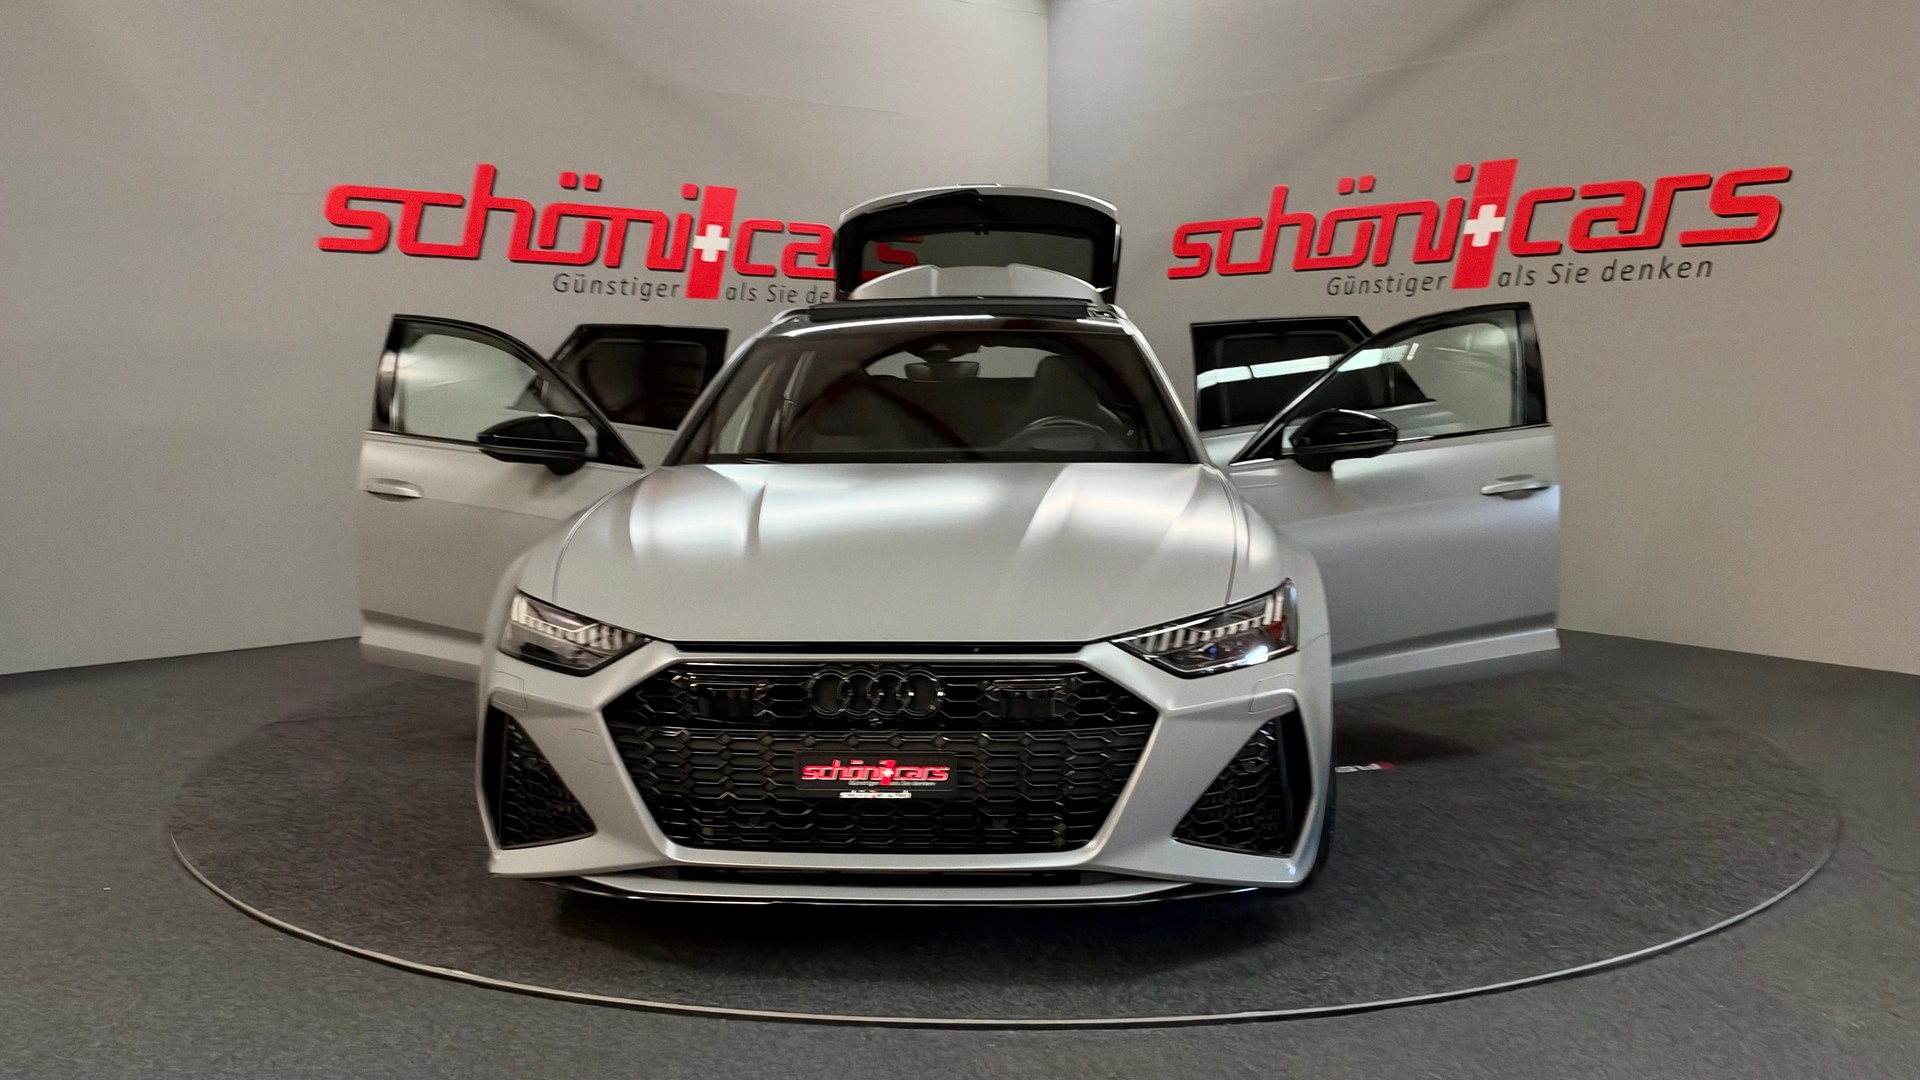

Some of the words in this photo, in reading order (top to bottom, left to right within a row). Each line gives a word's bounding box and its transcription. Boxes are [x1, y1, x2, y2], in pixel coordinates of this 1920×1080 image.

[552, 272, 681, 301] Günstiger
[725, 282, 759, 301] als
[766, 284, 799, 303] Sie
[1326, 273, 1448, 298] Günstiger
[1497, 264, 1536, 288] als
[1547, 261, 1590, 285] Sie
[1601, 255, 1714, 282] denken
